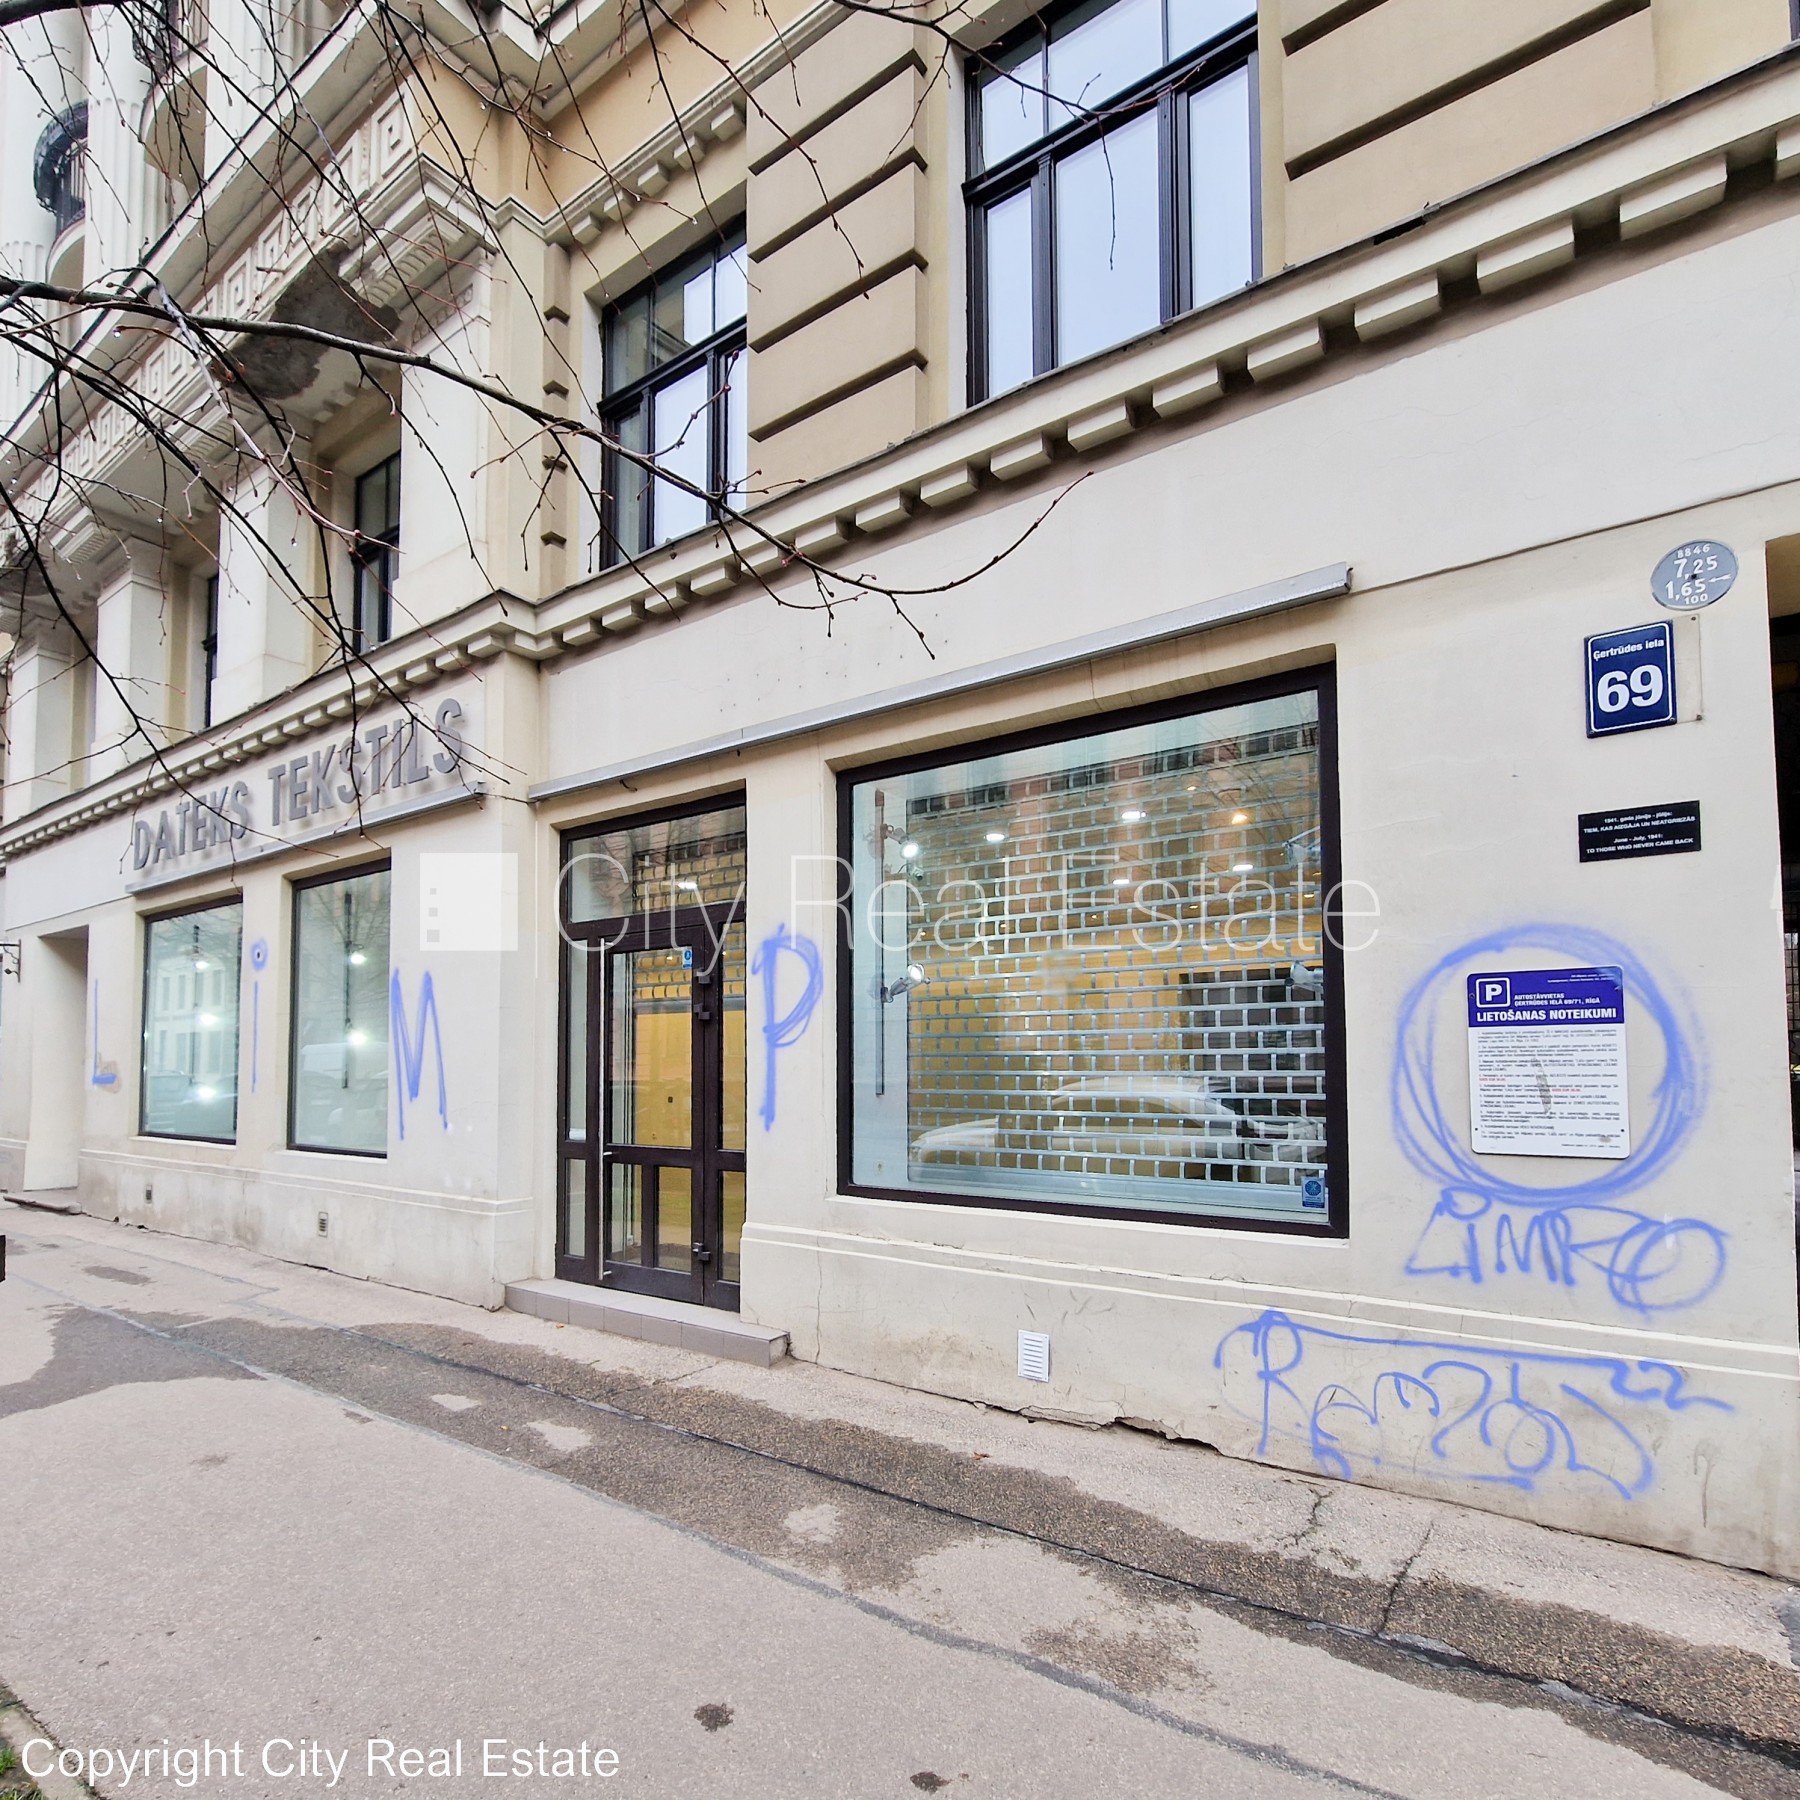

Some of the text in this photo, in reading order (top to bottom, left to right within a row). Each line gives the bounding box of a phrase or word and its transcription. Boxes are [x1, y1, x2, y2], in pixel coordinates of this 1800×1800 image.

[1677, 543, 1711, 559] 8846
[1673, 555, 1718, 580] 7,25
[1665, 578, 1707, 601] 1,65
[1684, 593, 1709, 605] 100
[1593, 643, 1643, 661] Ģertrūdes
[1597, 664, 1664, 713] 69
[133, 698, 463, 871] DATEKS TEKSTILS
[1596, 845, 1616, 853] THOSE
[1633, 842, 1655, 850] NEVER
[1655, 839, 1674, 848] CAME
[1675, 837, 1694, 845] BACK
[1485, 983, 1503, 1002] P
[1477, 1007, 1617, 1022] LIETOŠANAS NOTEIKUMI
